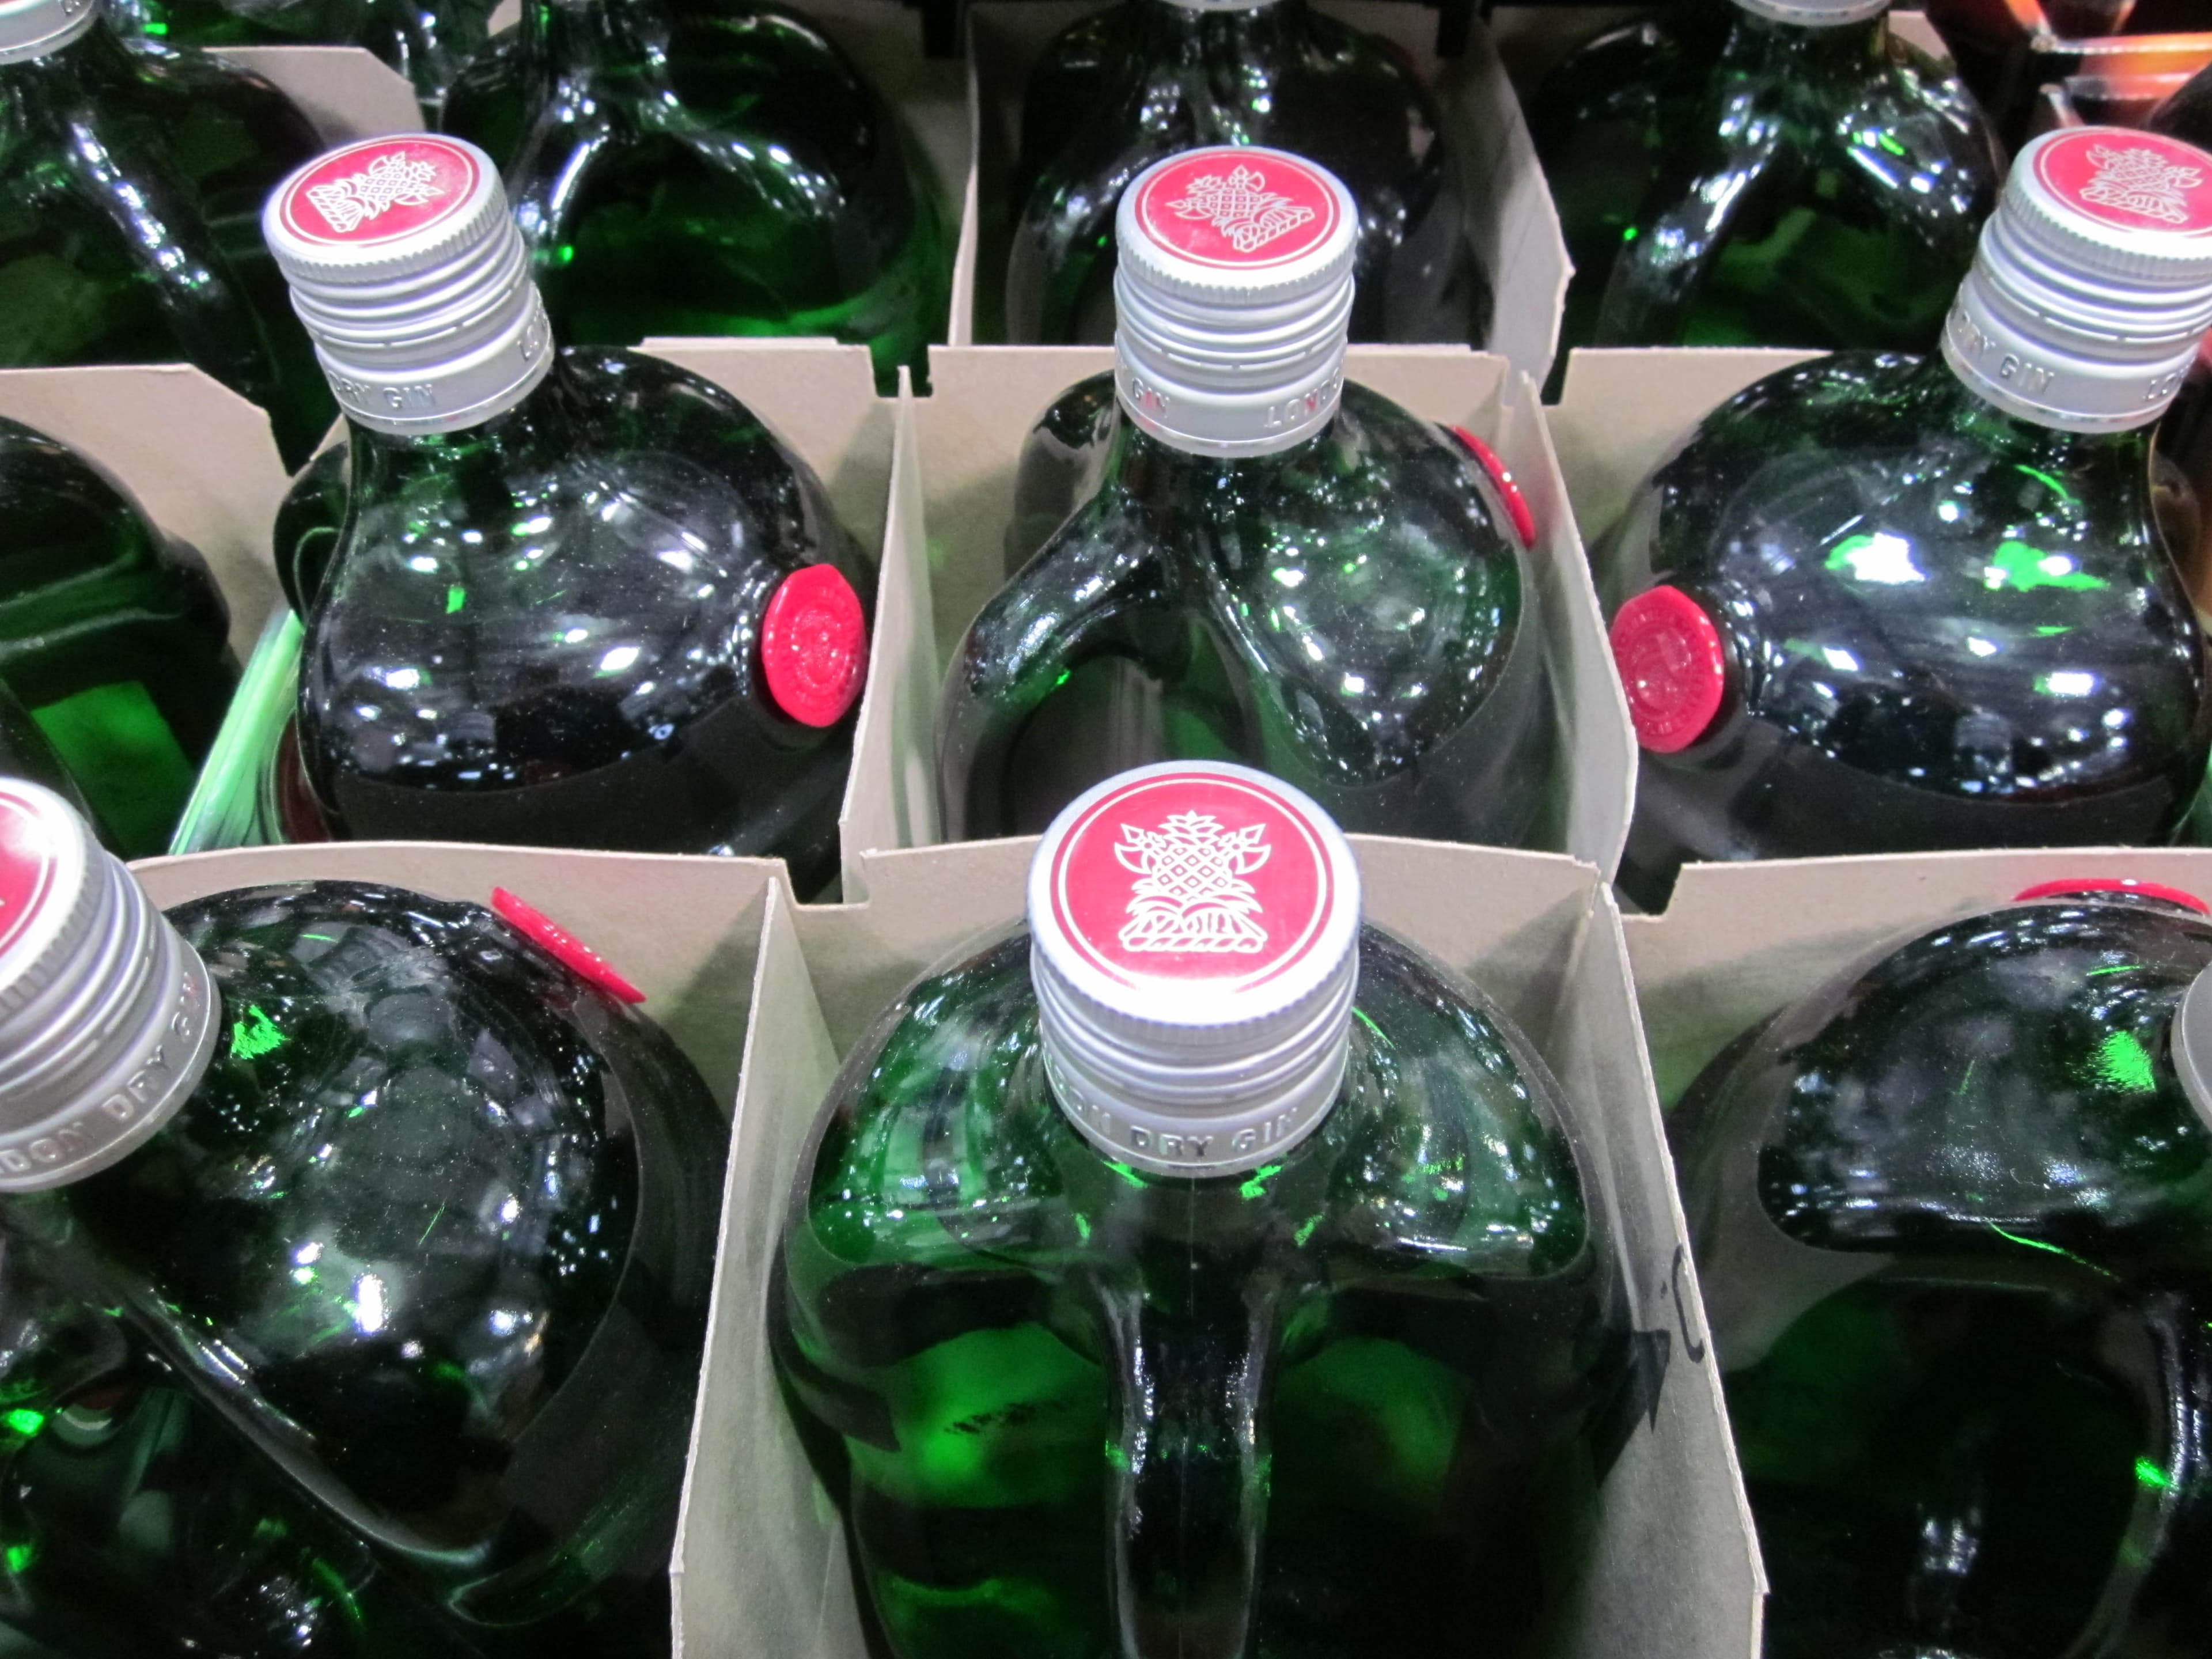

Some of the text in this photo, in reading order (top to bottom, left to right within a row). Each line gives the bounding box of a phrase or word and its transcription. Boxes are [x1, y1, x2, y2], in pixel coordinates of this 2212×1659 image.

[382, 383, 436, 408] GIN
[2000, 353, 2055, 395] GIN
[1130, 376, 1169, 419] GIN
[101, 1044, 171, 1121] DRY
[1130, 1125, 1213, 1157] DRY
[1232, 1107, 1297, 1153] GIN
